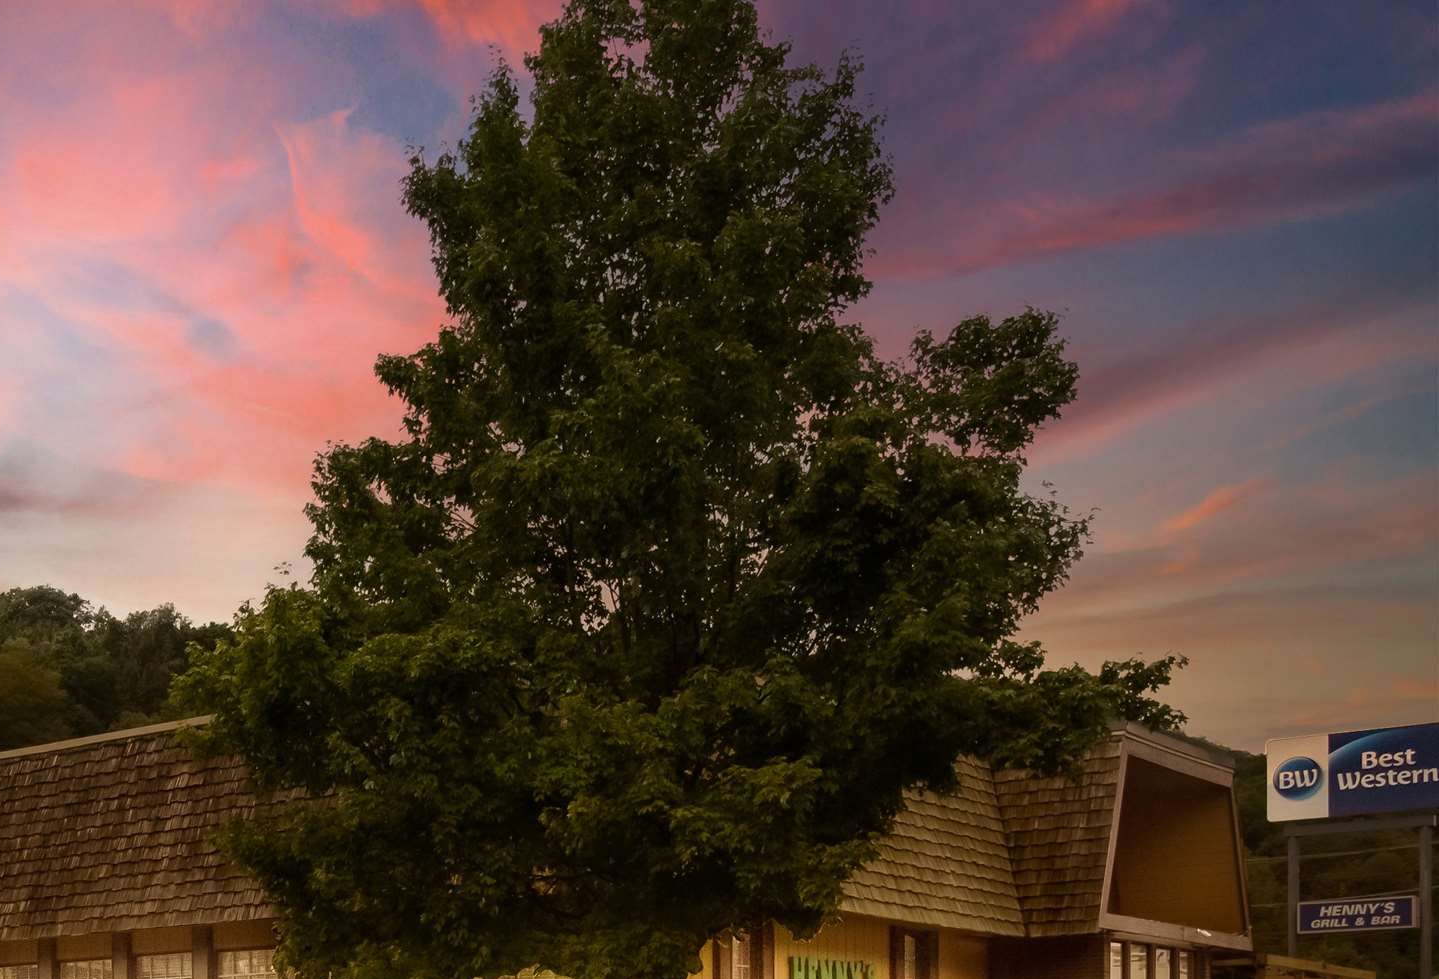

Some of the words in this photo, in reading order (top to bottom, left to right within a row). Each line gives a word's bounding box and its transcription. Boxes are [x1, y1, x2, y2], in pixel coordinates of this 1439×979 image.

[1361, 749, 1416, 769] Best
[1279, 768, 1318, 790] BW
[1337, 767, 1438, 790] Western
[1320, 902, 1396, 917] HENNY'S
[1311, 918, 1349, 929] GRILL
[1355, 917, 1365, 926] &
[1371, 915, 1400, 925] BAR
